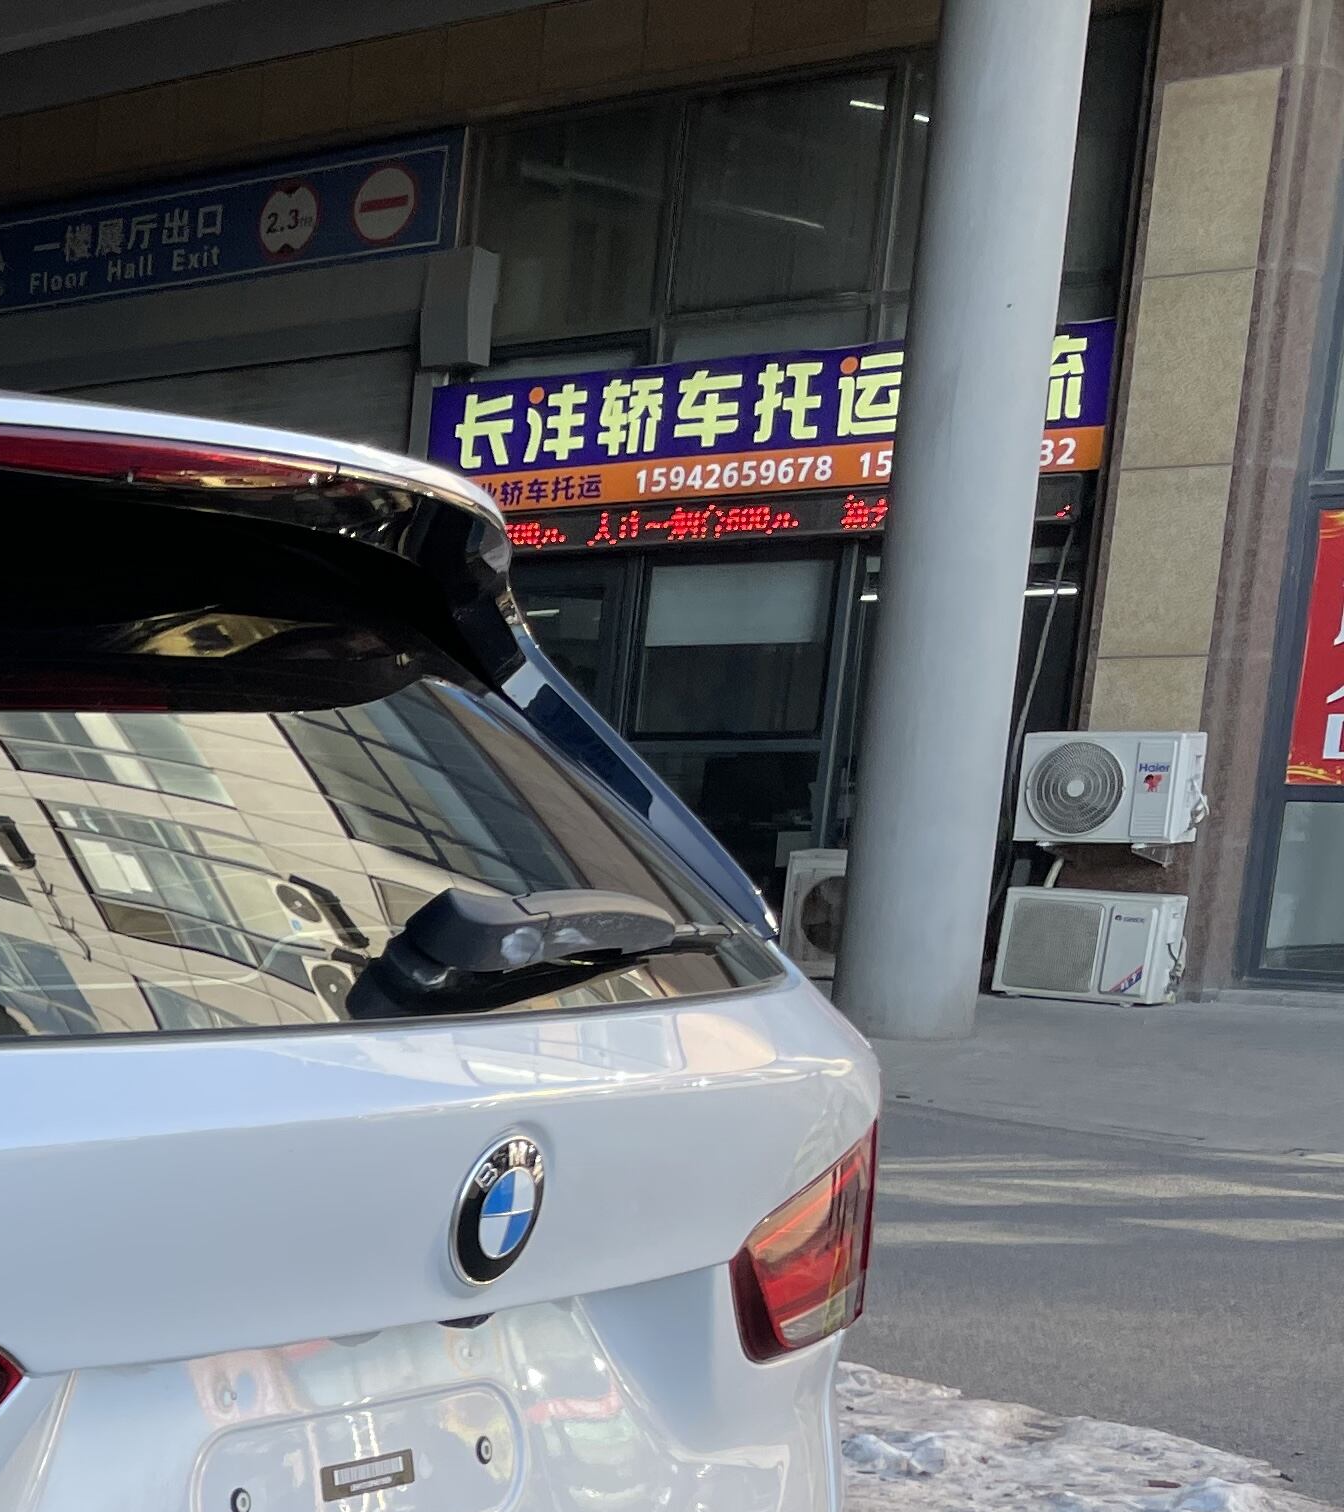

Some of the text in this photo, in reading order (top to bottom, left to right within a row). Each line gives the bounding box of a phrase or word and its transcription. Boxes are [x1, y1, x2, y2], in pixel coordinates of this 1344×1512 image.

[29, 270, 88, 295] Floor
[107, 254, 153, 282] Hall
[172, 245, 221, 272] Exit
[636, 455, 833, 494] 15942659678
[1139, 763, 1169, 772] Haier
[475, 1141, 544, 1189] BMW
